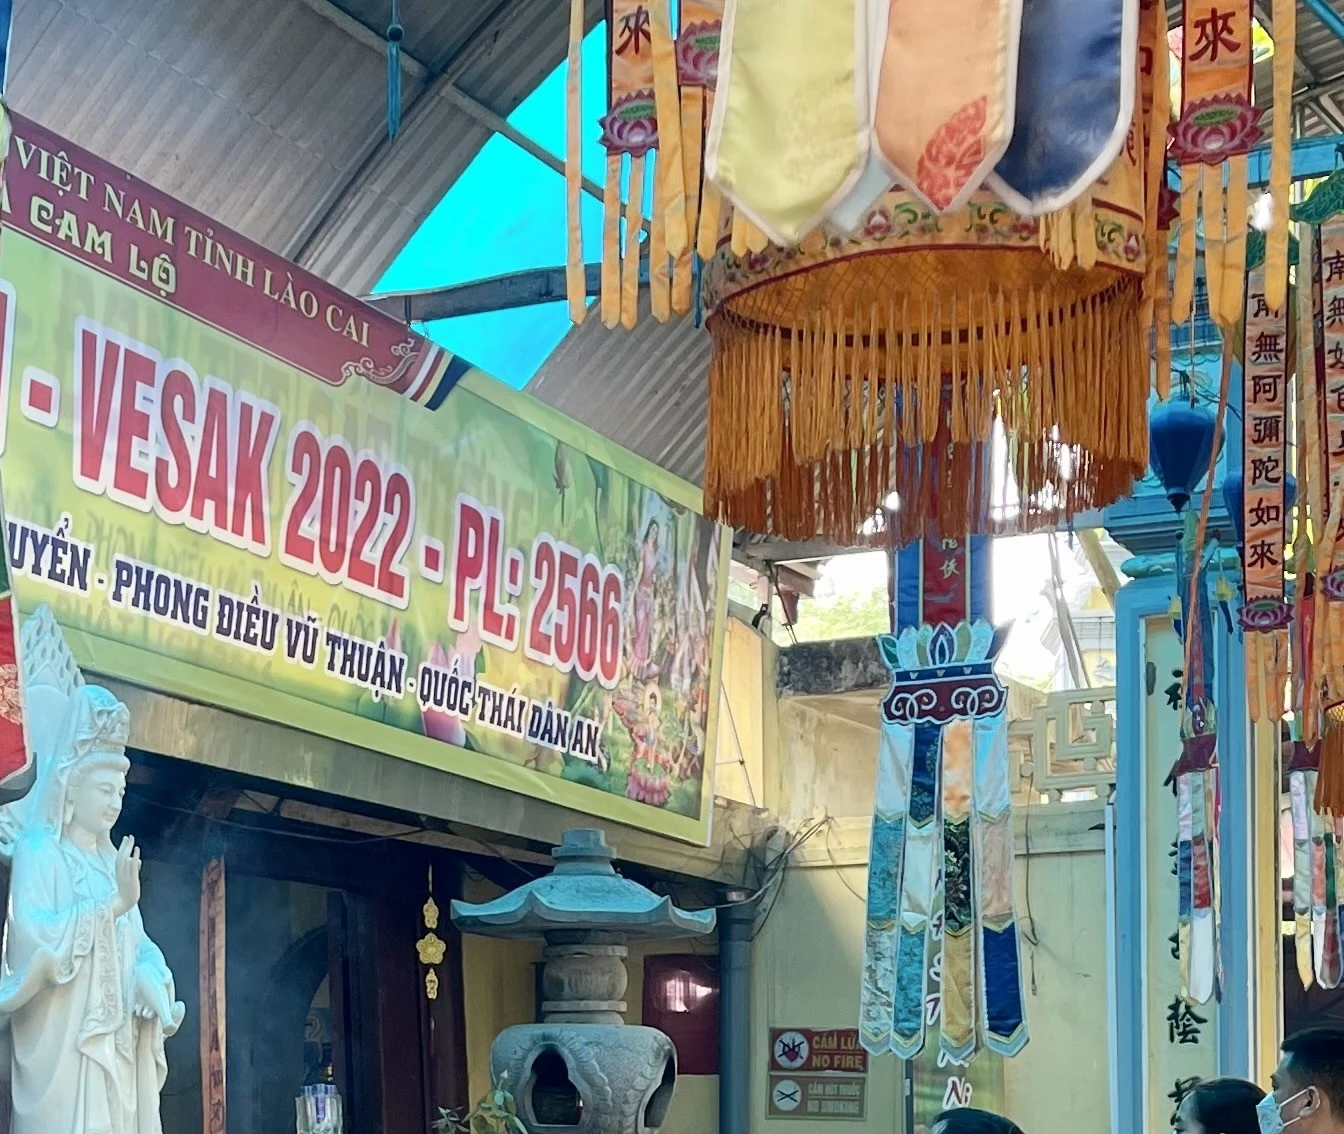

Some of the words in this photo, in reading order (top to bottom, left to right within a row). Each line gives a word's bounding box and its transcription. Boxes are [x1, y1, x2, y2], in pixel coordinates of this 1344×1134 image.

[1190, 8, 1241, 62] 來
[15, 134, 96, 198] VIỆT
[104, 190, 176, 246] NAM
[184, 226, 256, 287] TỈNH
[263, 266, 319, 320] LÀO
[324, 304, 371, 348] CAI
[29, 196, 114, 261] CAM
[128, 243, 177, 298] LỘ
[80, 328, 277, 545] VESAK
[284, 430, 412, 601] 2022
[454, 500, 522, 642] PL:
[529, 541, 622, 682] 2566
[6, 518, 92, 591] UYỂN
[112, 560, 209, 629] PHONG
[216, 584, 279, 651] ĐIỀU
[287, 616, 318, 664] VŨ
[326, 632, 406, 701] THUẬN
[420, 658, 473, 714] QUỐC
[478, 682, 526, 733] THÁI
[528, 697, 568, 746] DÂN
[571, 721, 599, 757] AN
[812, 1055, 830, 1068] NO
[834, 1055, 864, 1068] FIRE
